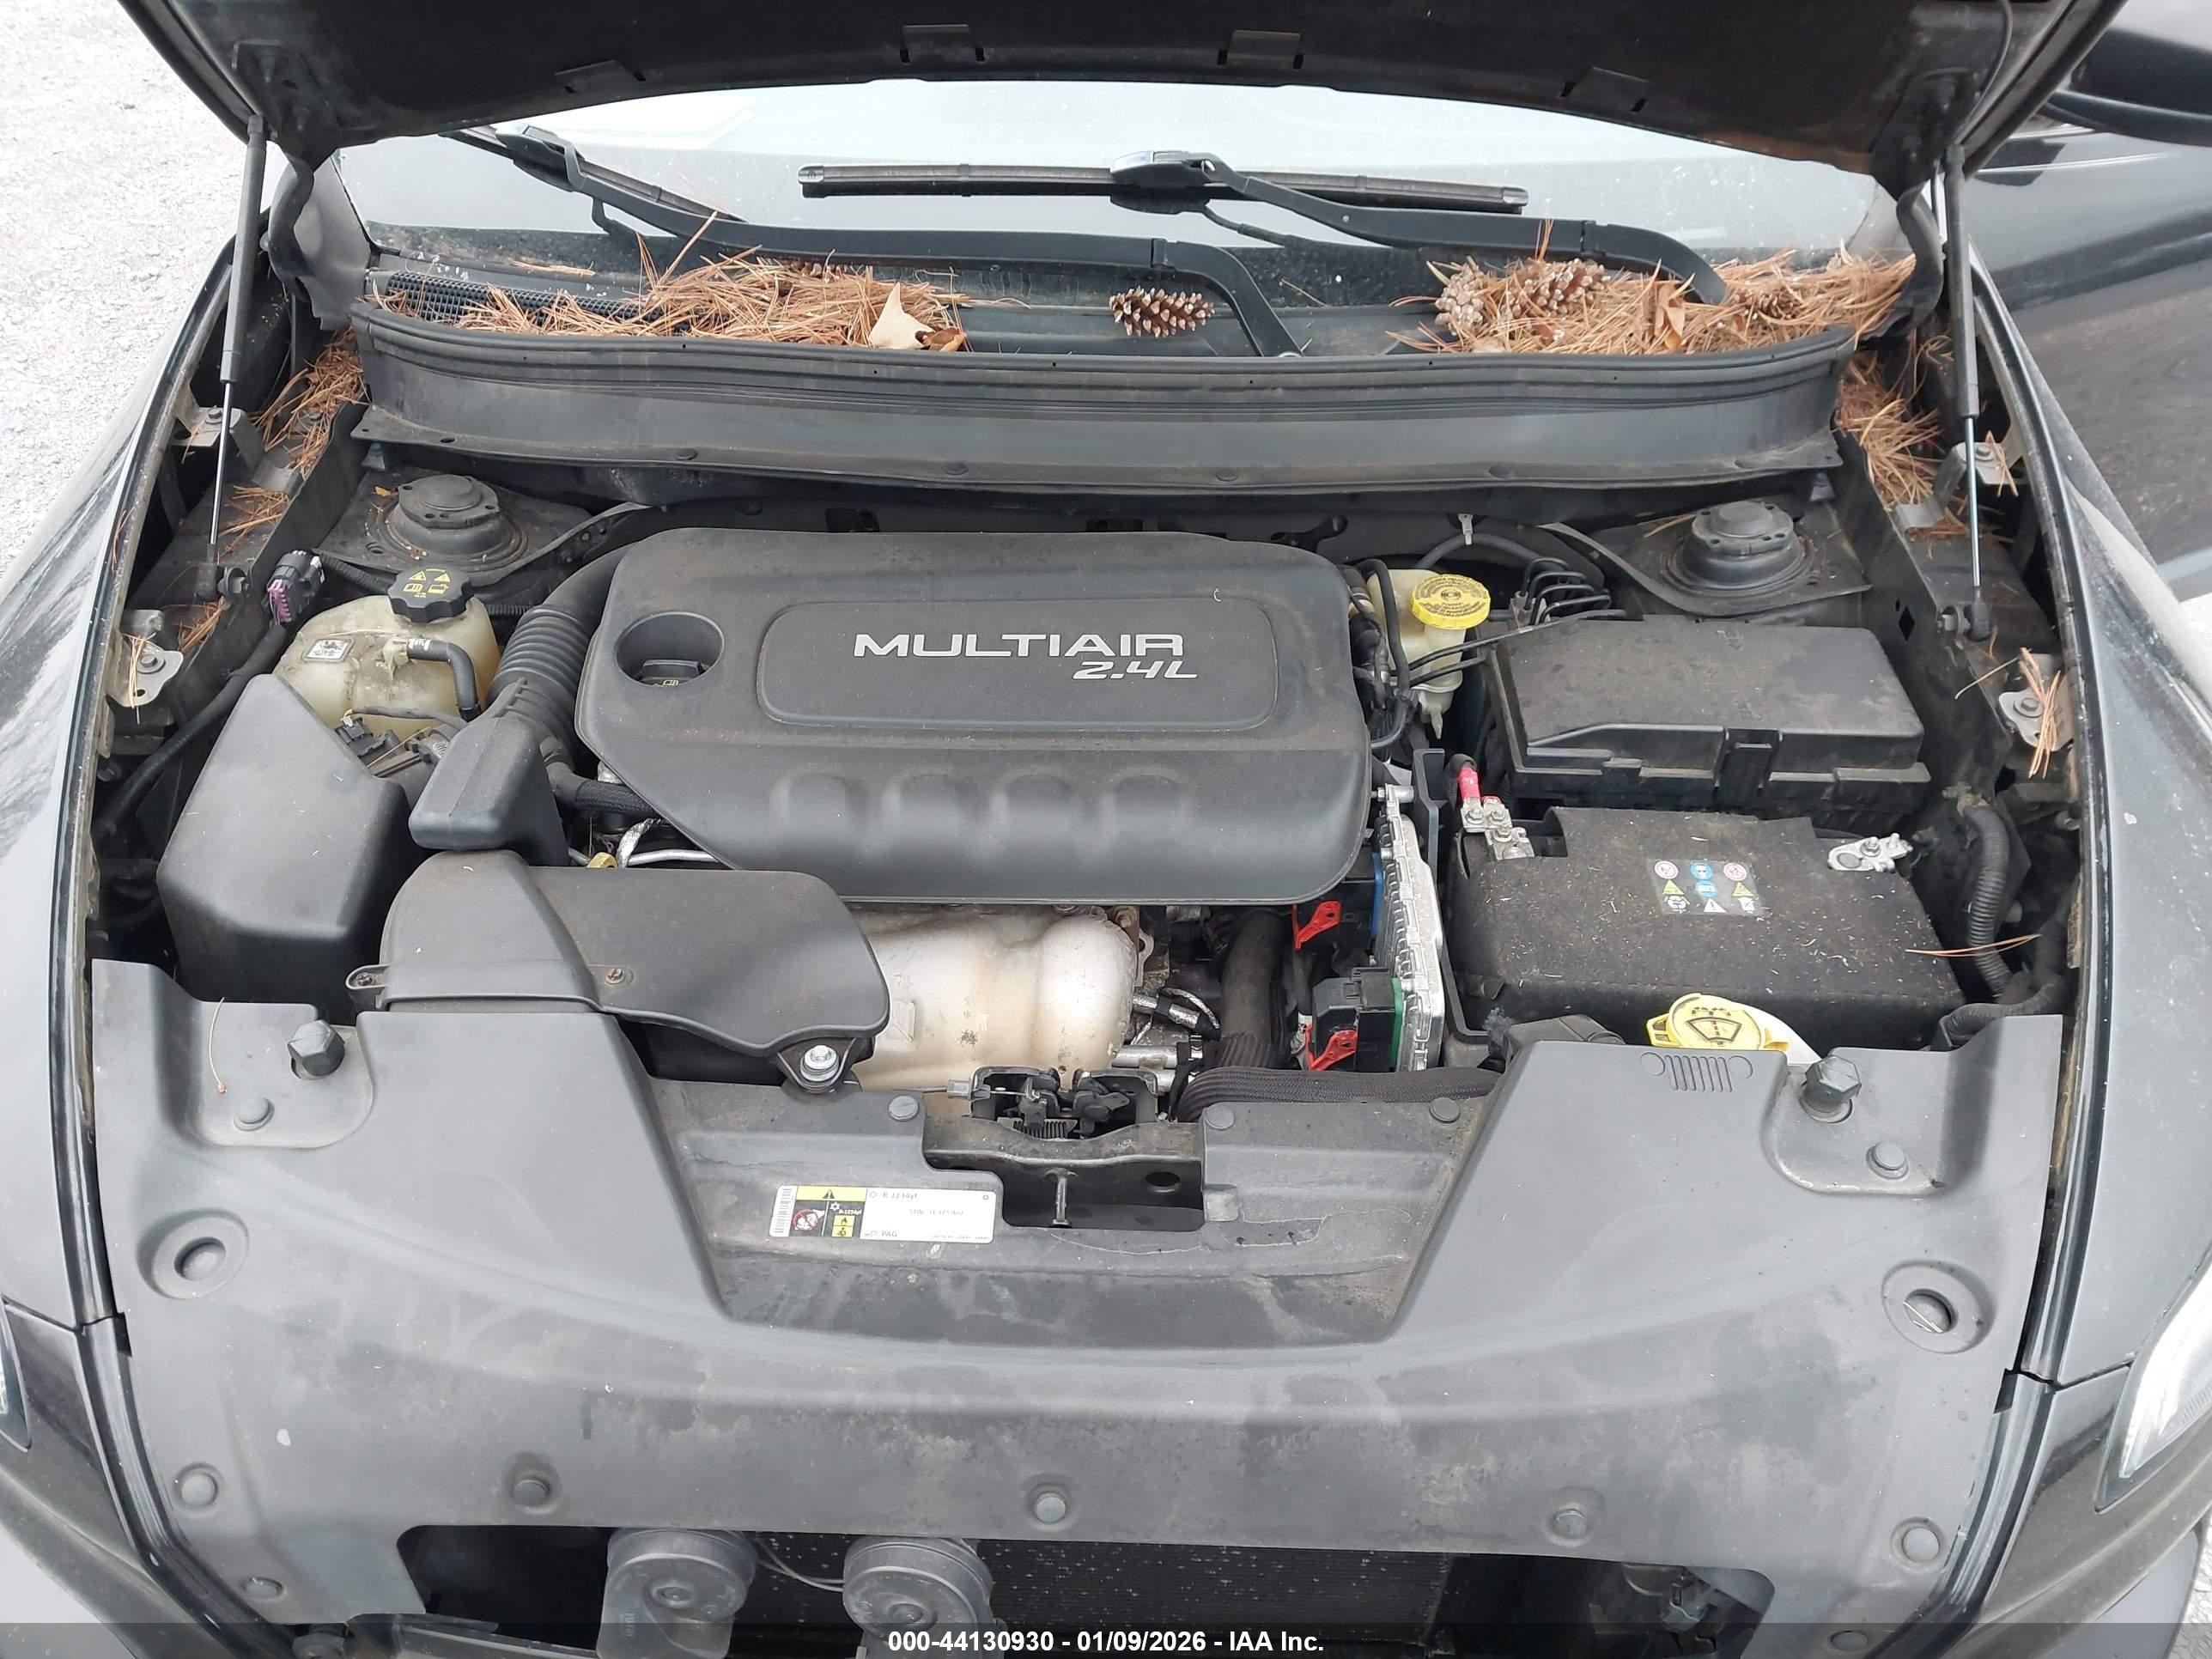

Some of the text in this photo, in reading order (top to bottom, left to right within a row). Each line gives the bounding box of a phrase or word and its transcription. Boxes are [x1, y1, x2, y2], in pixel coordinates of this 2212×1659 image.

[854, 634, 1183, 657] MULTIAIR
[1073, 660, 1198, 679] 2.4L
[881, 1230, 898, 1238] PAG
